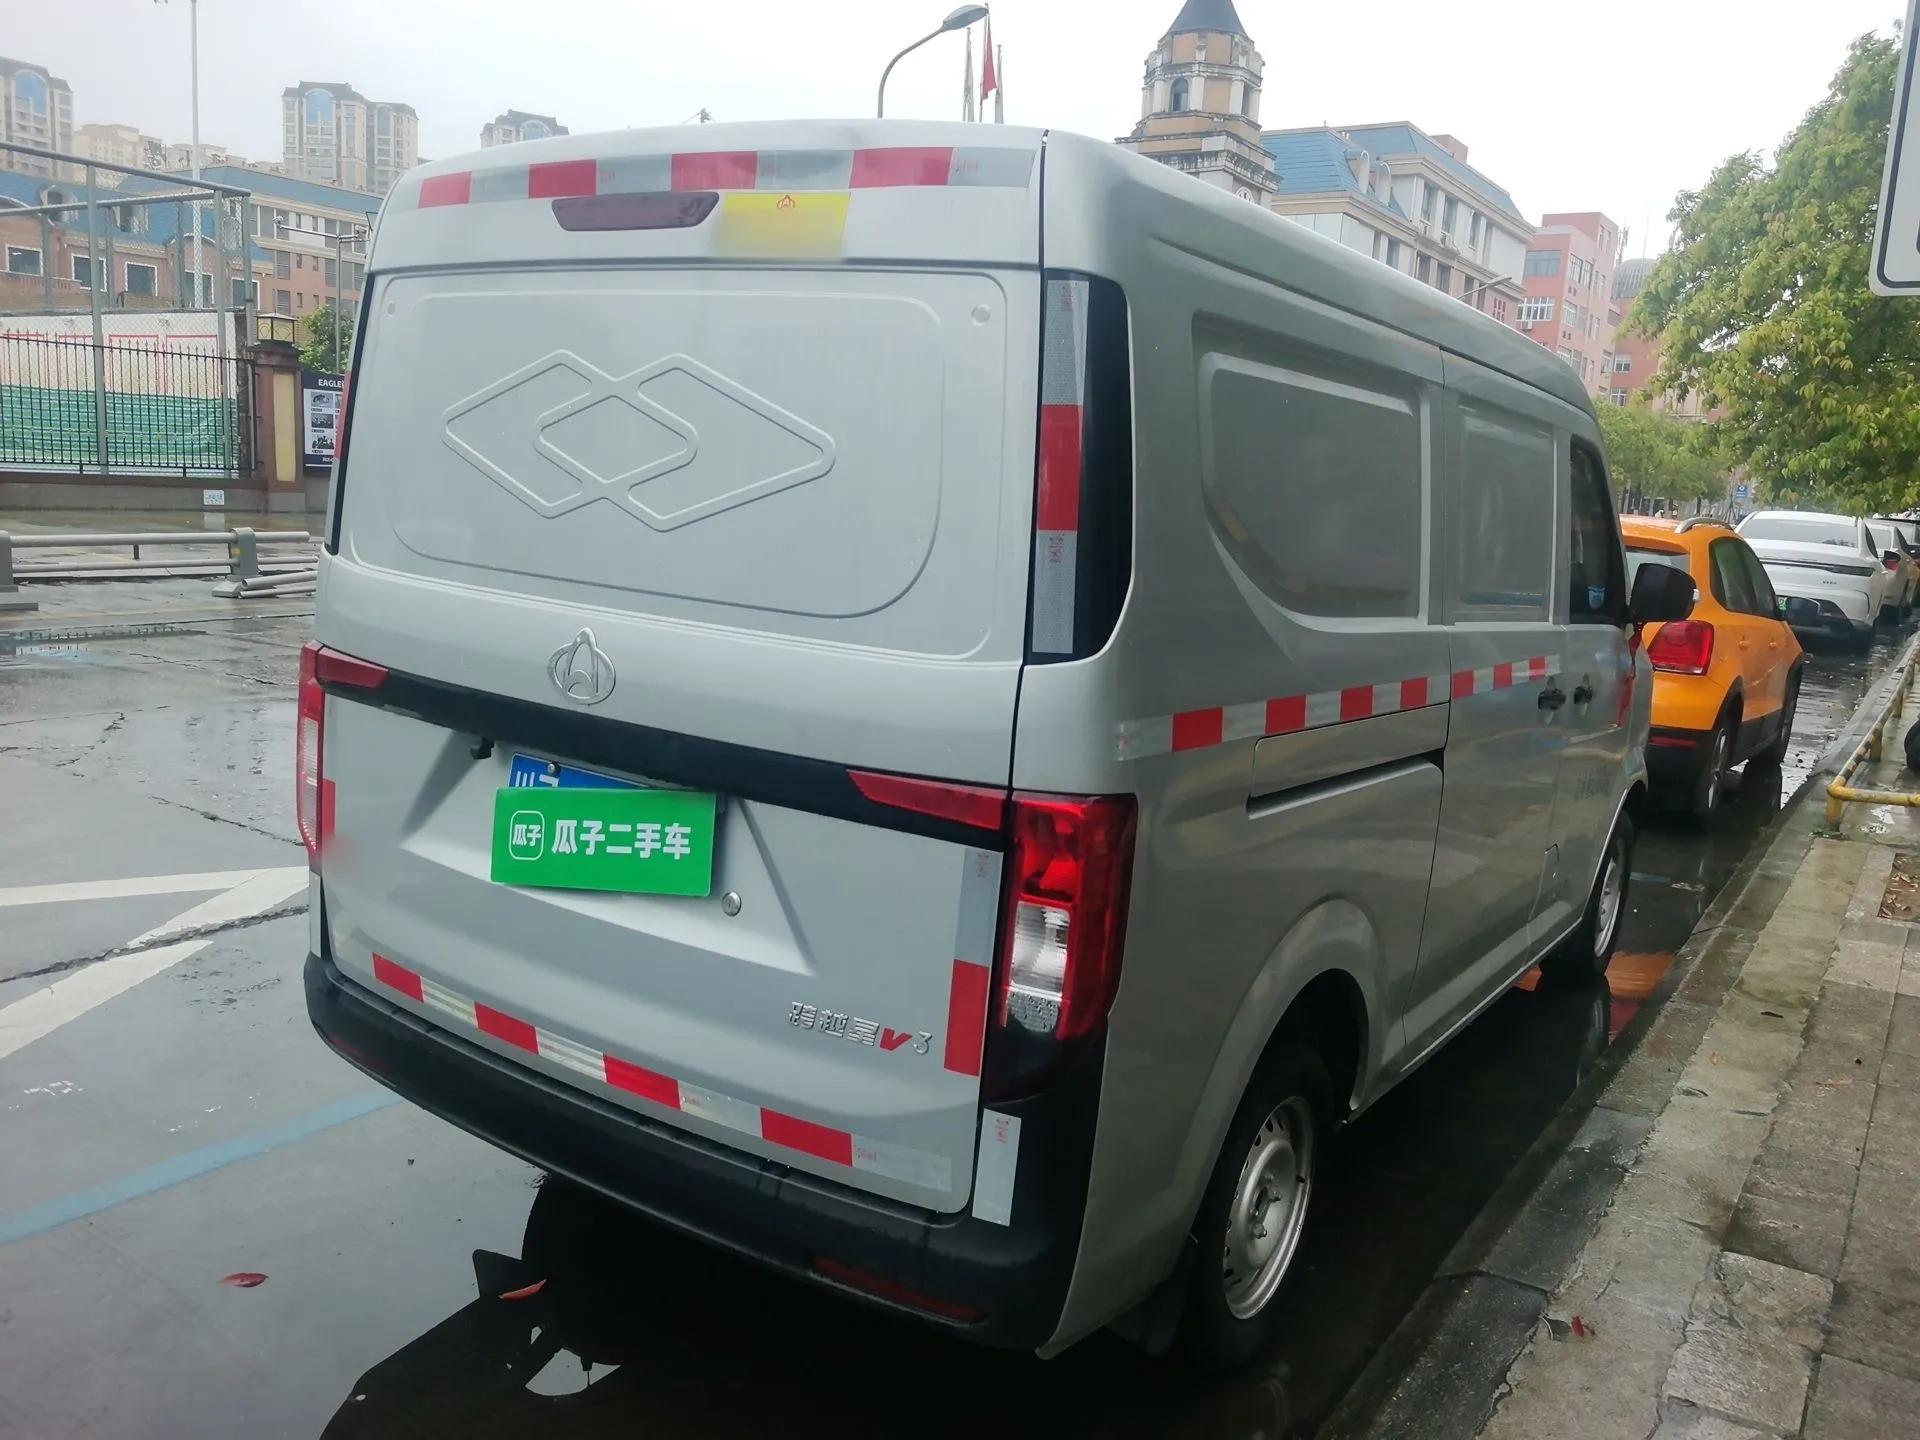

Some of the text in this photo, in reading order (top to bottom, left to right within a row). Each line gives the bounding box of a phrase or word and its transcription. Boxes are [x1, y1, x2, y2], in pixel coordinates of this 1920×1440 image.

[512, 819, 692, 860] 瓜子 瓜子二手车
